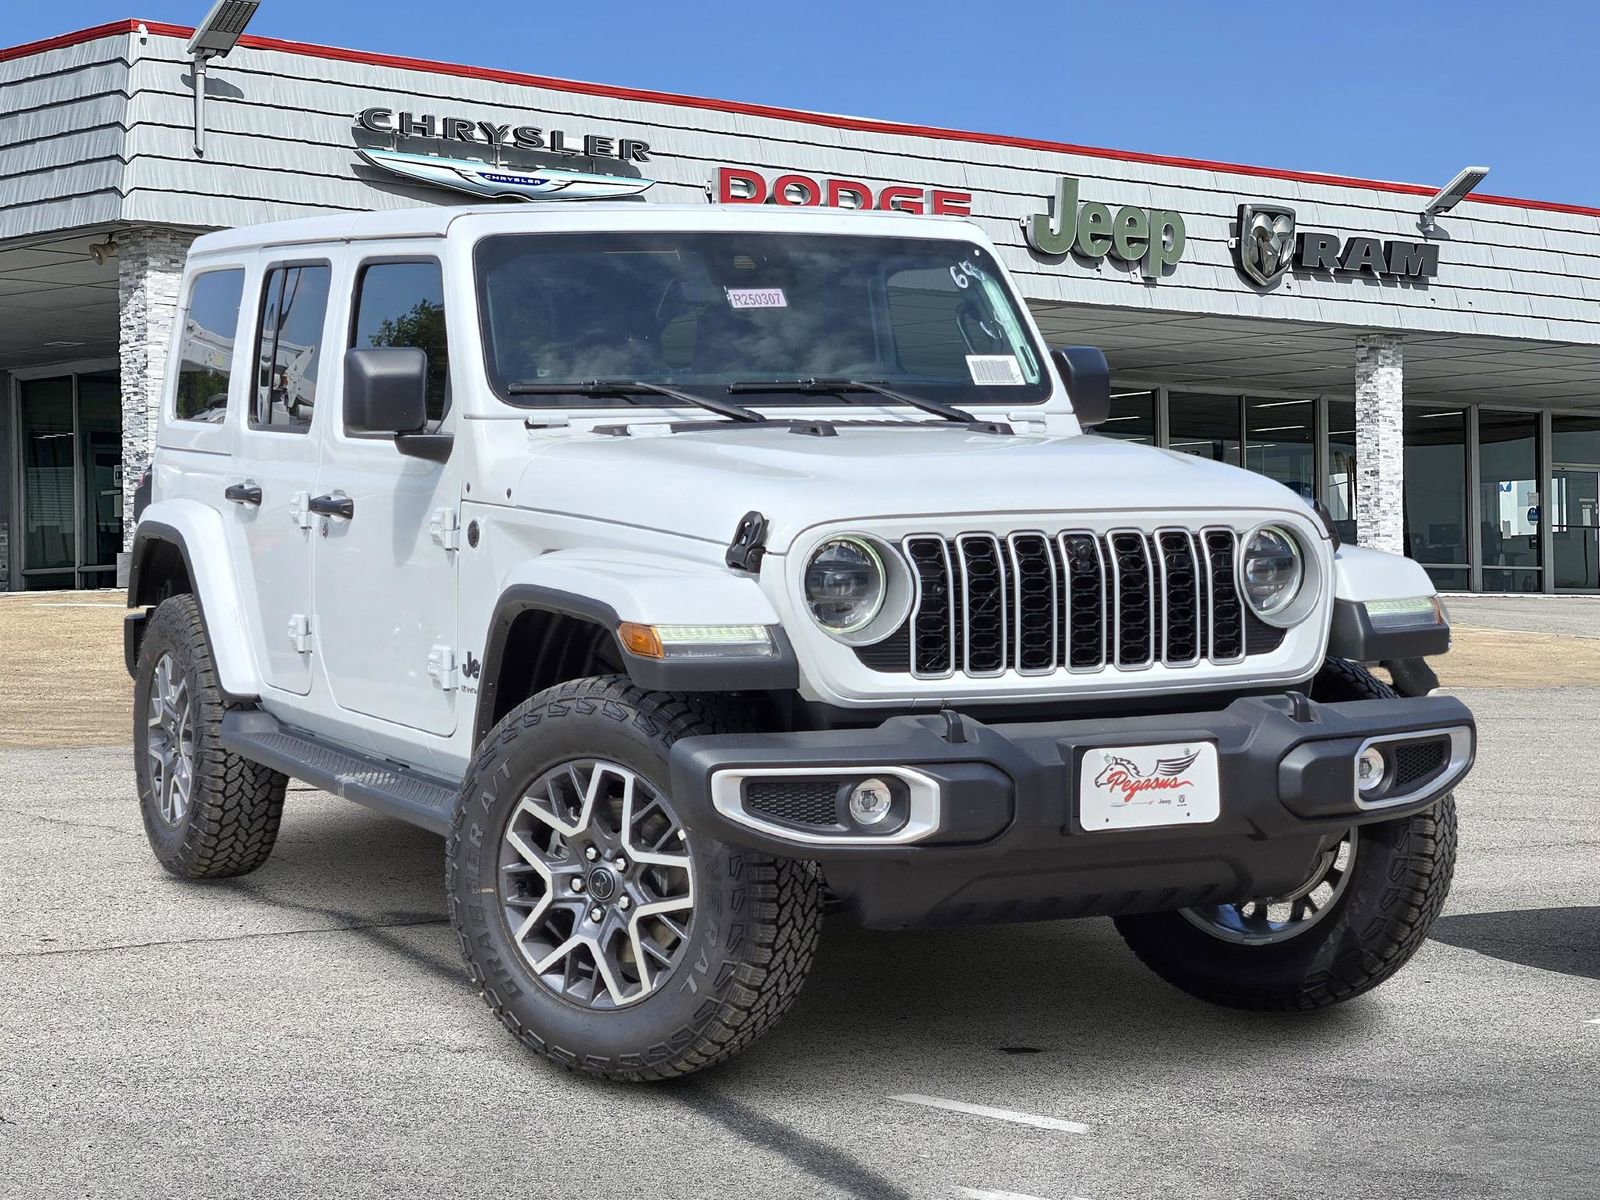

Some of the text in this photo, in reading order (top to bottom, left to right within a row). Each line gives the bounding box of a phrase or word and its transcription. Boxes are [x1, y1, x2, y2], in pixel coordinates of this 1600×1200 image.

[357, 107, 651, 162] CHRYSLER
[484, 174, 541, 185] CHRYSLER
[712, 166, 972, 217] DODGE
[1028, 176, 1186, 278] Jeep
[1299, 231, 1440, 277] RAM
[733, 293, 781, 305] R250307
[1106, 770, 1194, 802] Pegasus
